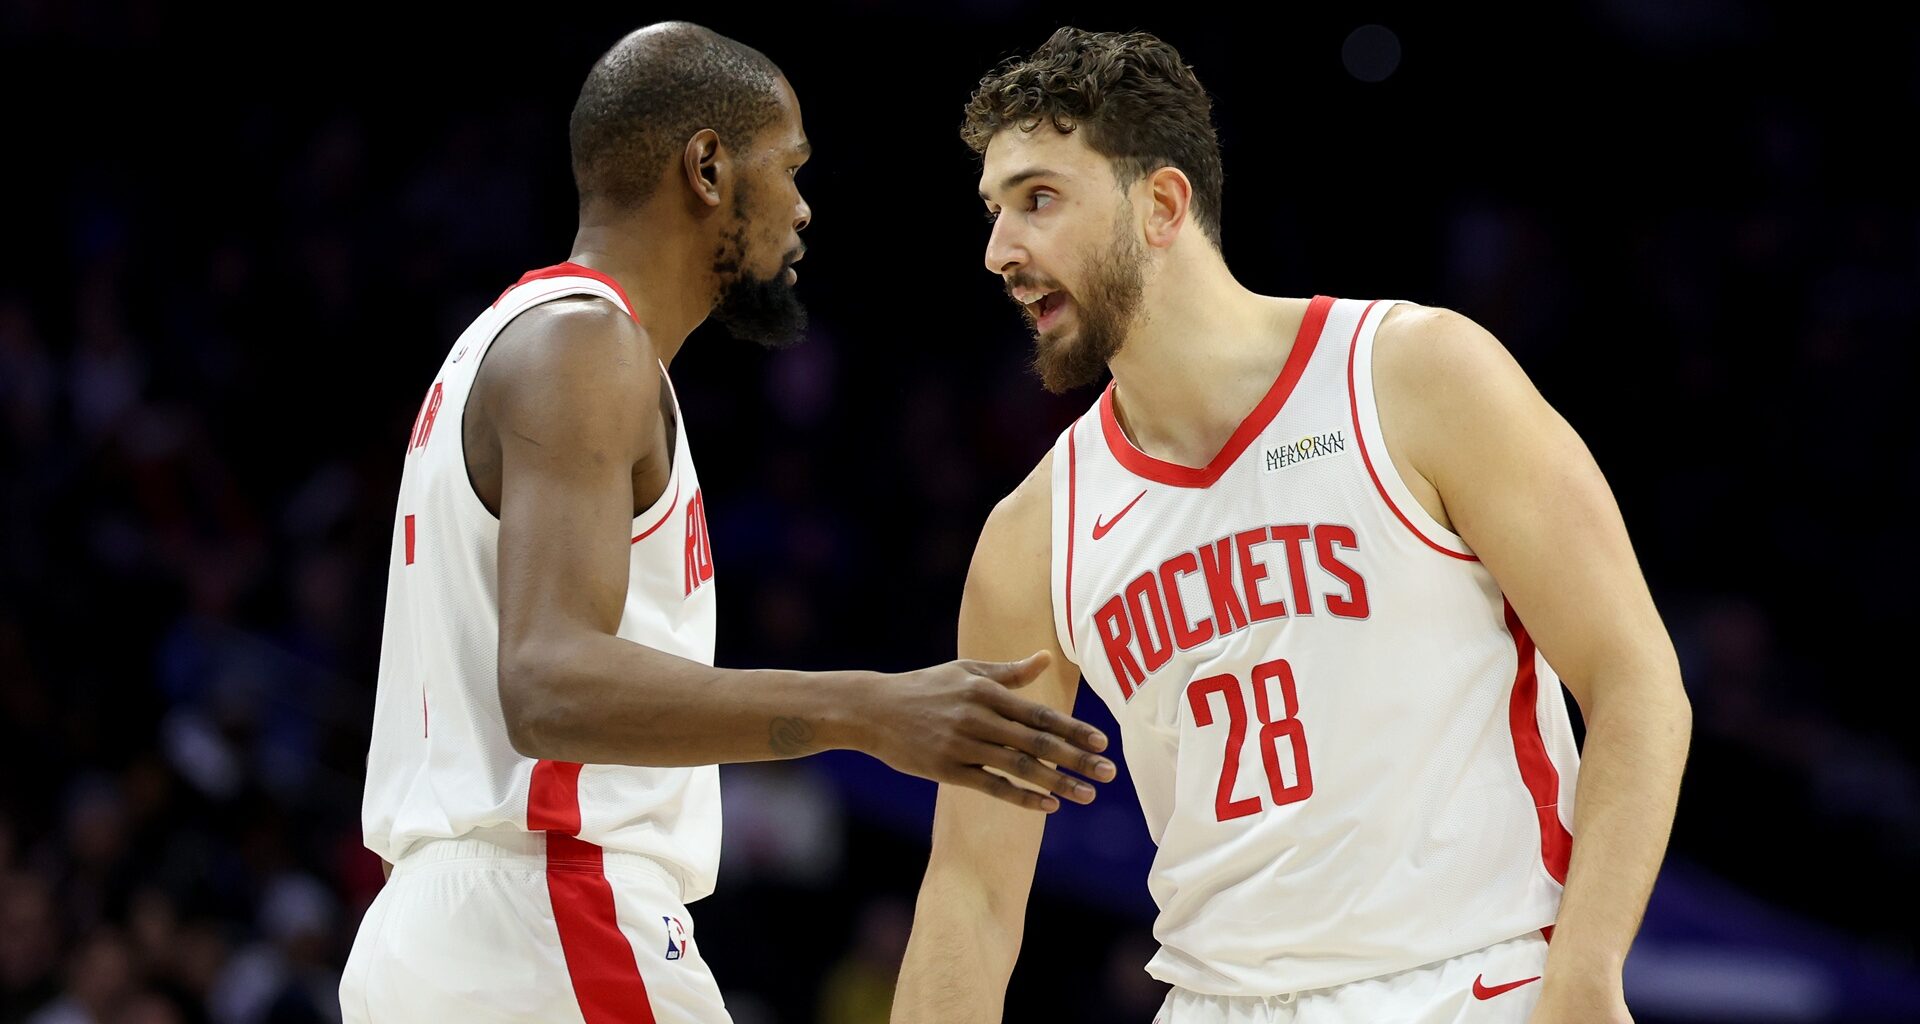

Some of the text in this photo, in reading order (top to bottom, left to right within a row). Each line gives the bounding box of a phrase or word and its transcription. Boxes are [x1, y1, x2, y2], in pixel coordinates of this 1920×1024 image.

[1266, 430, 1345, 462] MEMORIAL
[1266, 439, 1345, 471] HERMANN
[1093, 523, 1371, 703] ROCKETS
[1186, 658, 1314, 822] 28
